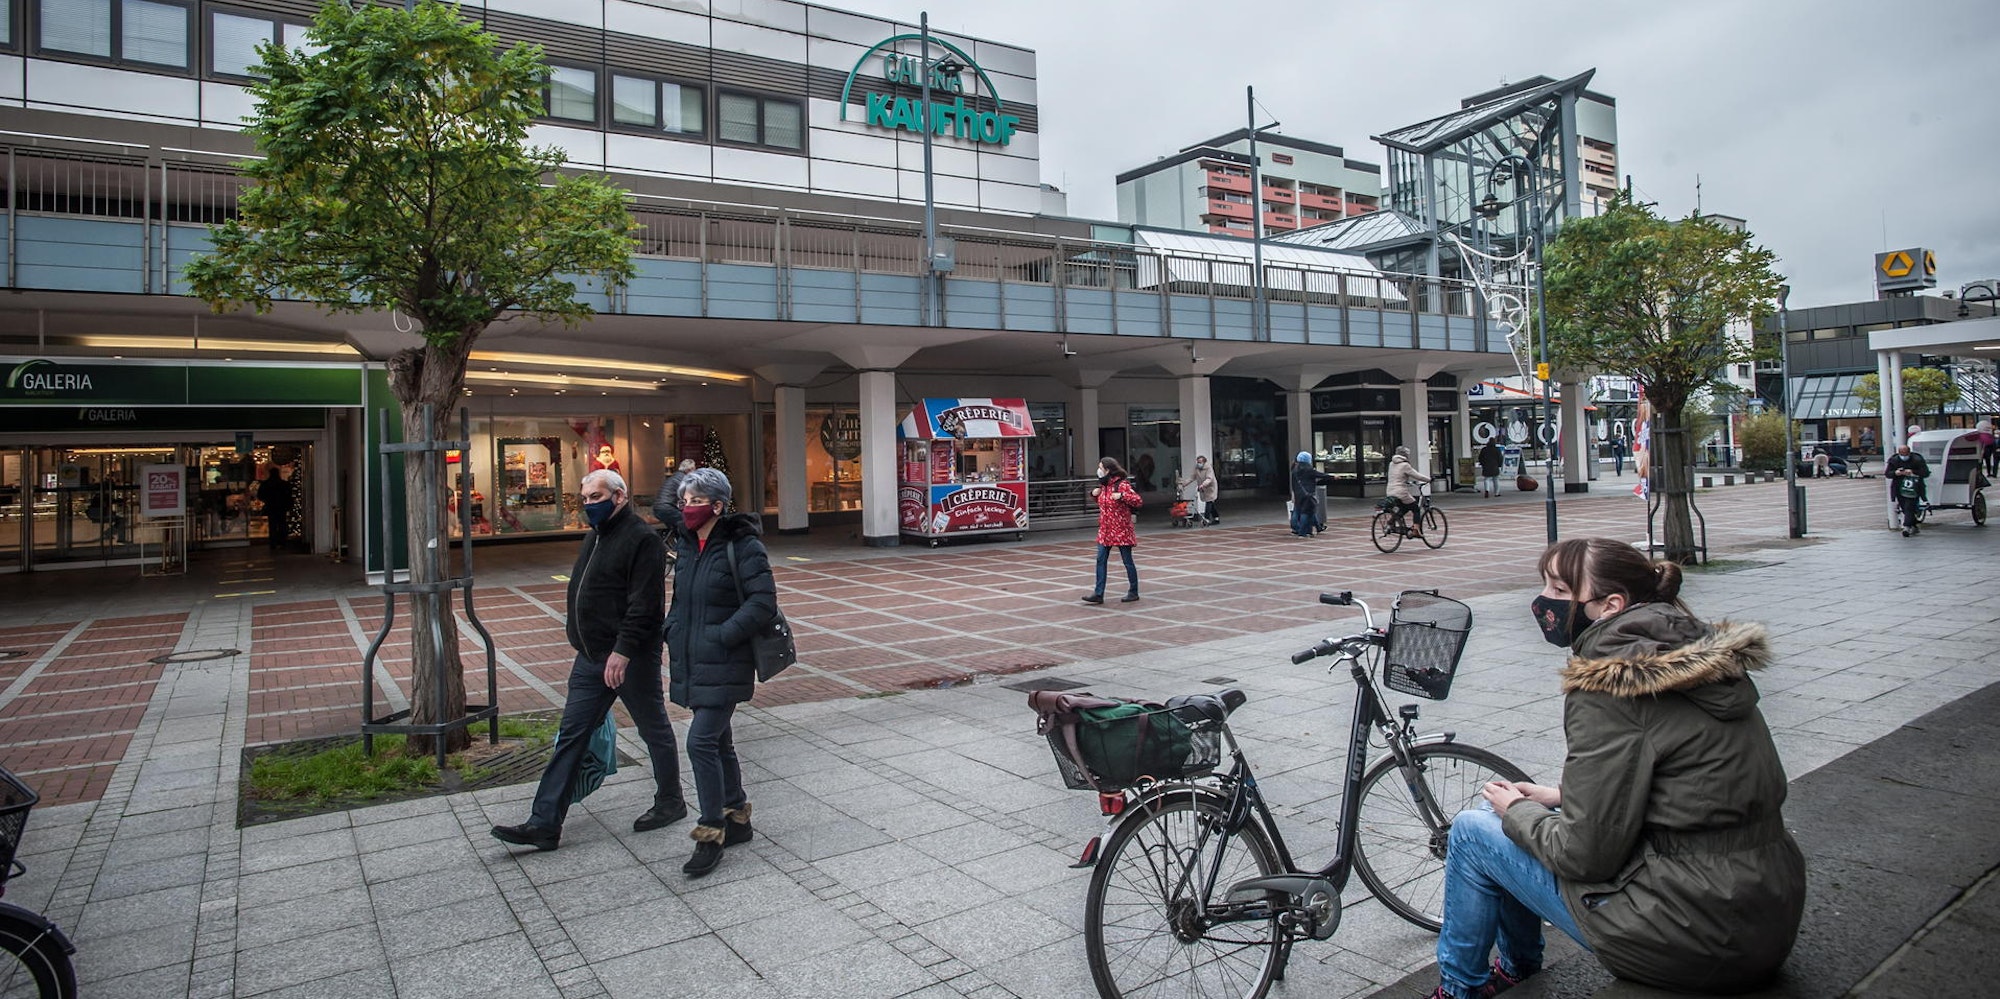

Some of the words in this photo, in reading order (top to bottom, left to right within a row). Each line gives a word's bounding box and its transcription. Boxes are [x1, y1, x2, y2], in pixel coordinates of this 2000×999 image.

[23, 373, 93, 390] GALERIA
[88, 409, 137, 421] GALERIA
[953, 489, 1006, 505] CRÊPERIE
